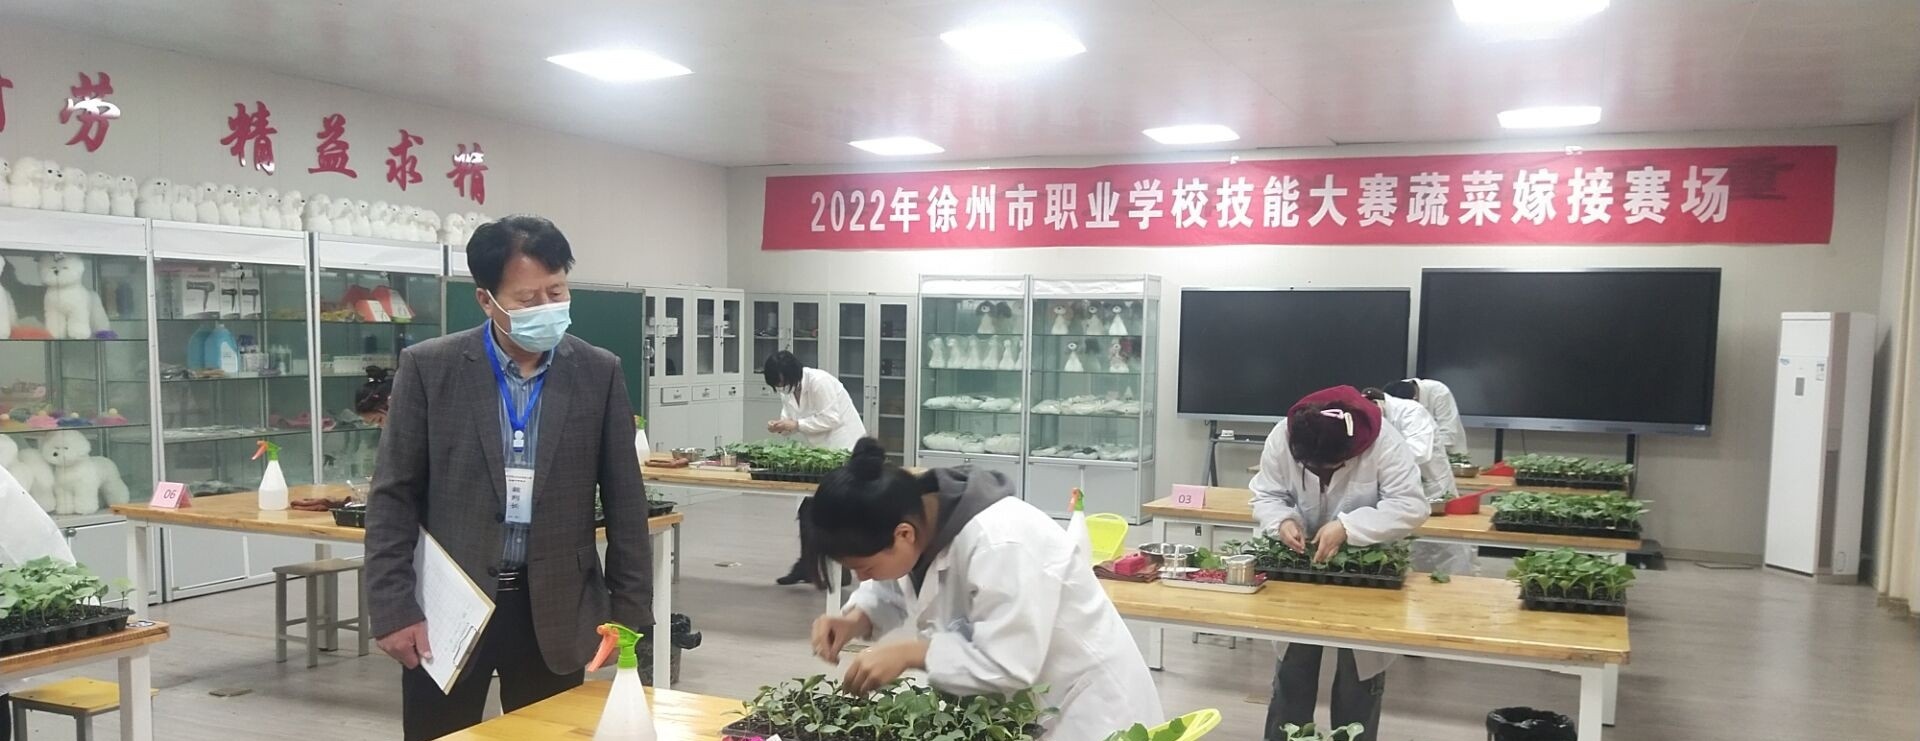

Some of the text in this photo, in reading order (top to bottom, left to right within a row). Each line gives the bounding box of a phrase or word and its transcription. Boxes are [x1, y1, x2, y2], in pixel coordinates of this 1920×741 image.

[220, 100, 489, 205] 精益求精
[811, 165, 1731, 234] 2022年徐州市职业学校技能大赛蔬菜嫁接赛场
[163, 489, 177, 499] 06
[1178, 494, 1192, 504] 03
